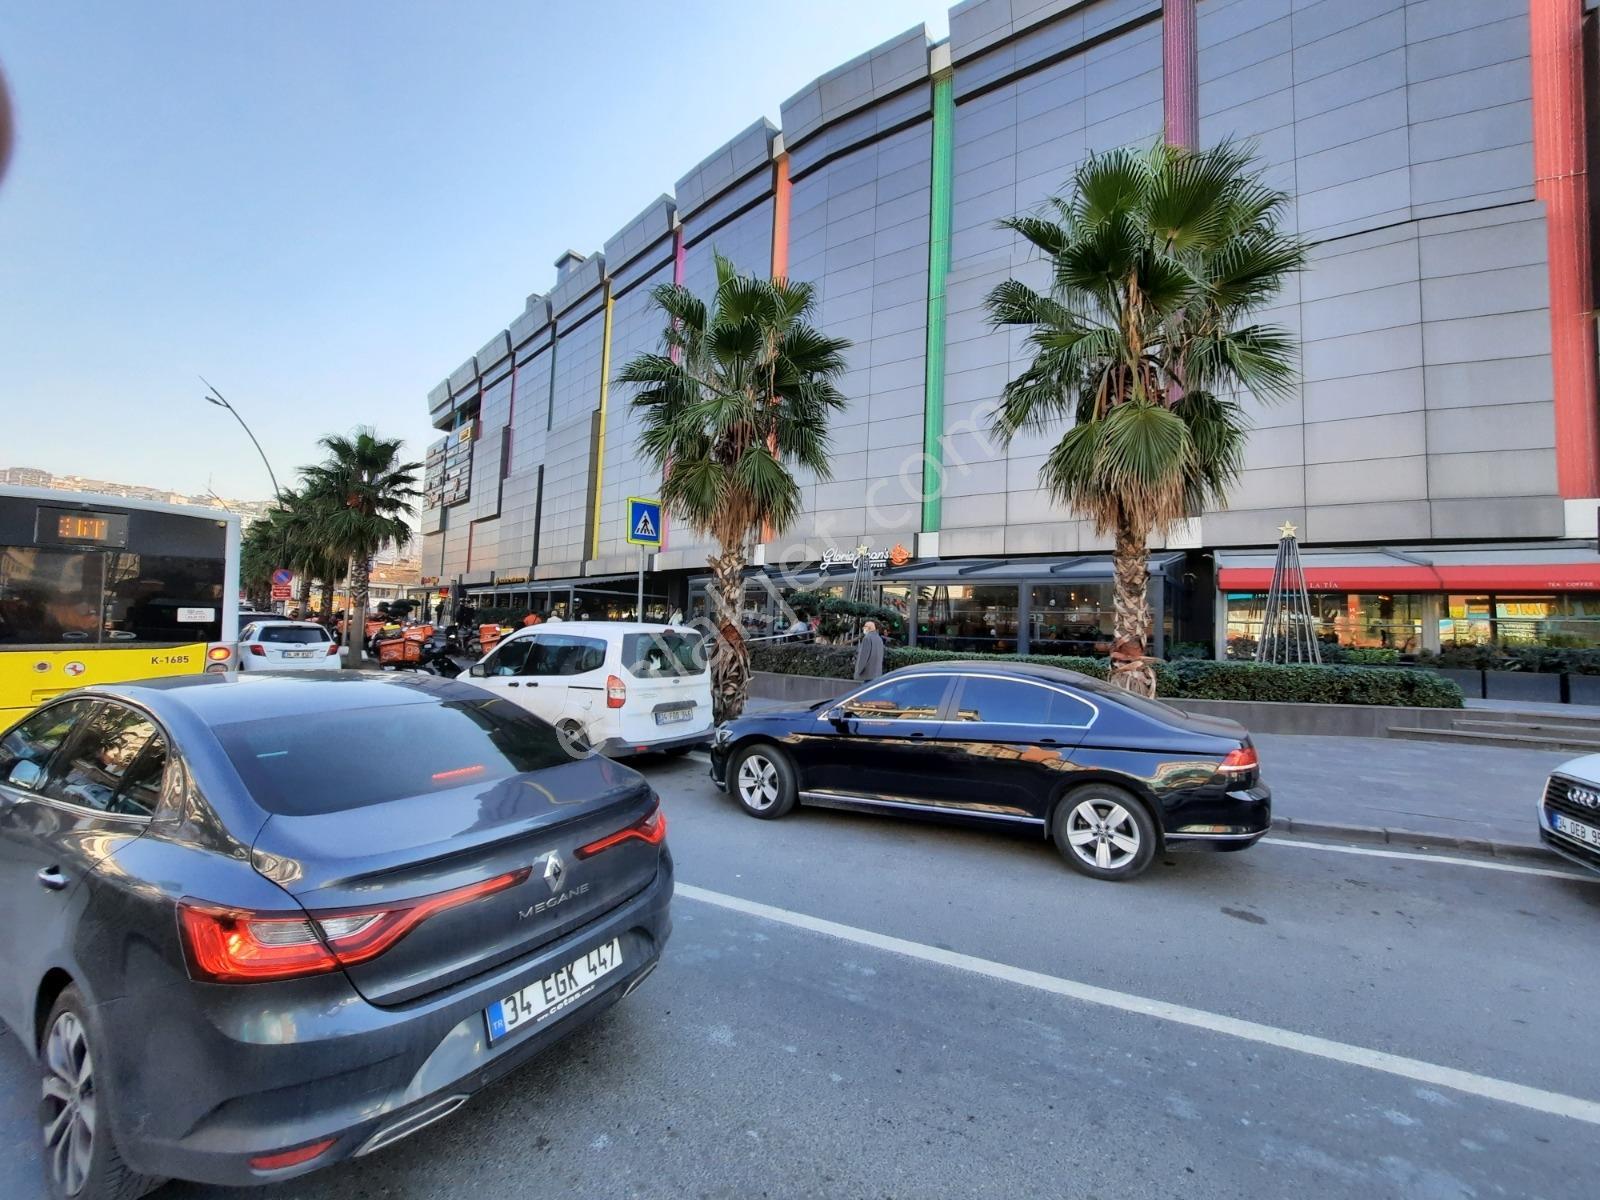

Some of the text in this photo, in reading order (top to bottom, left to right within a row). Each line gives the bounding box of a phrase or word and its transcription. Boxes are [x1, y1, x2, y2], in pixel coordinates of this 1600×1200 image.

[819, 547, 889, 570] Gloria Jan's
[151, 655, 190, 665] K-1685
[518, 883, 590, 921] MEGANE
[492, 941, 614, 1031] TR 34 EGK 447
